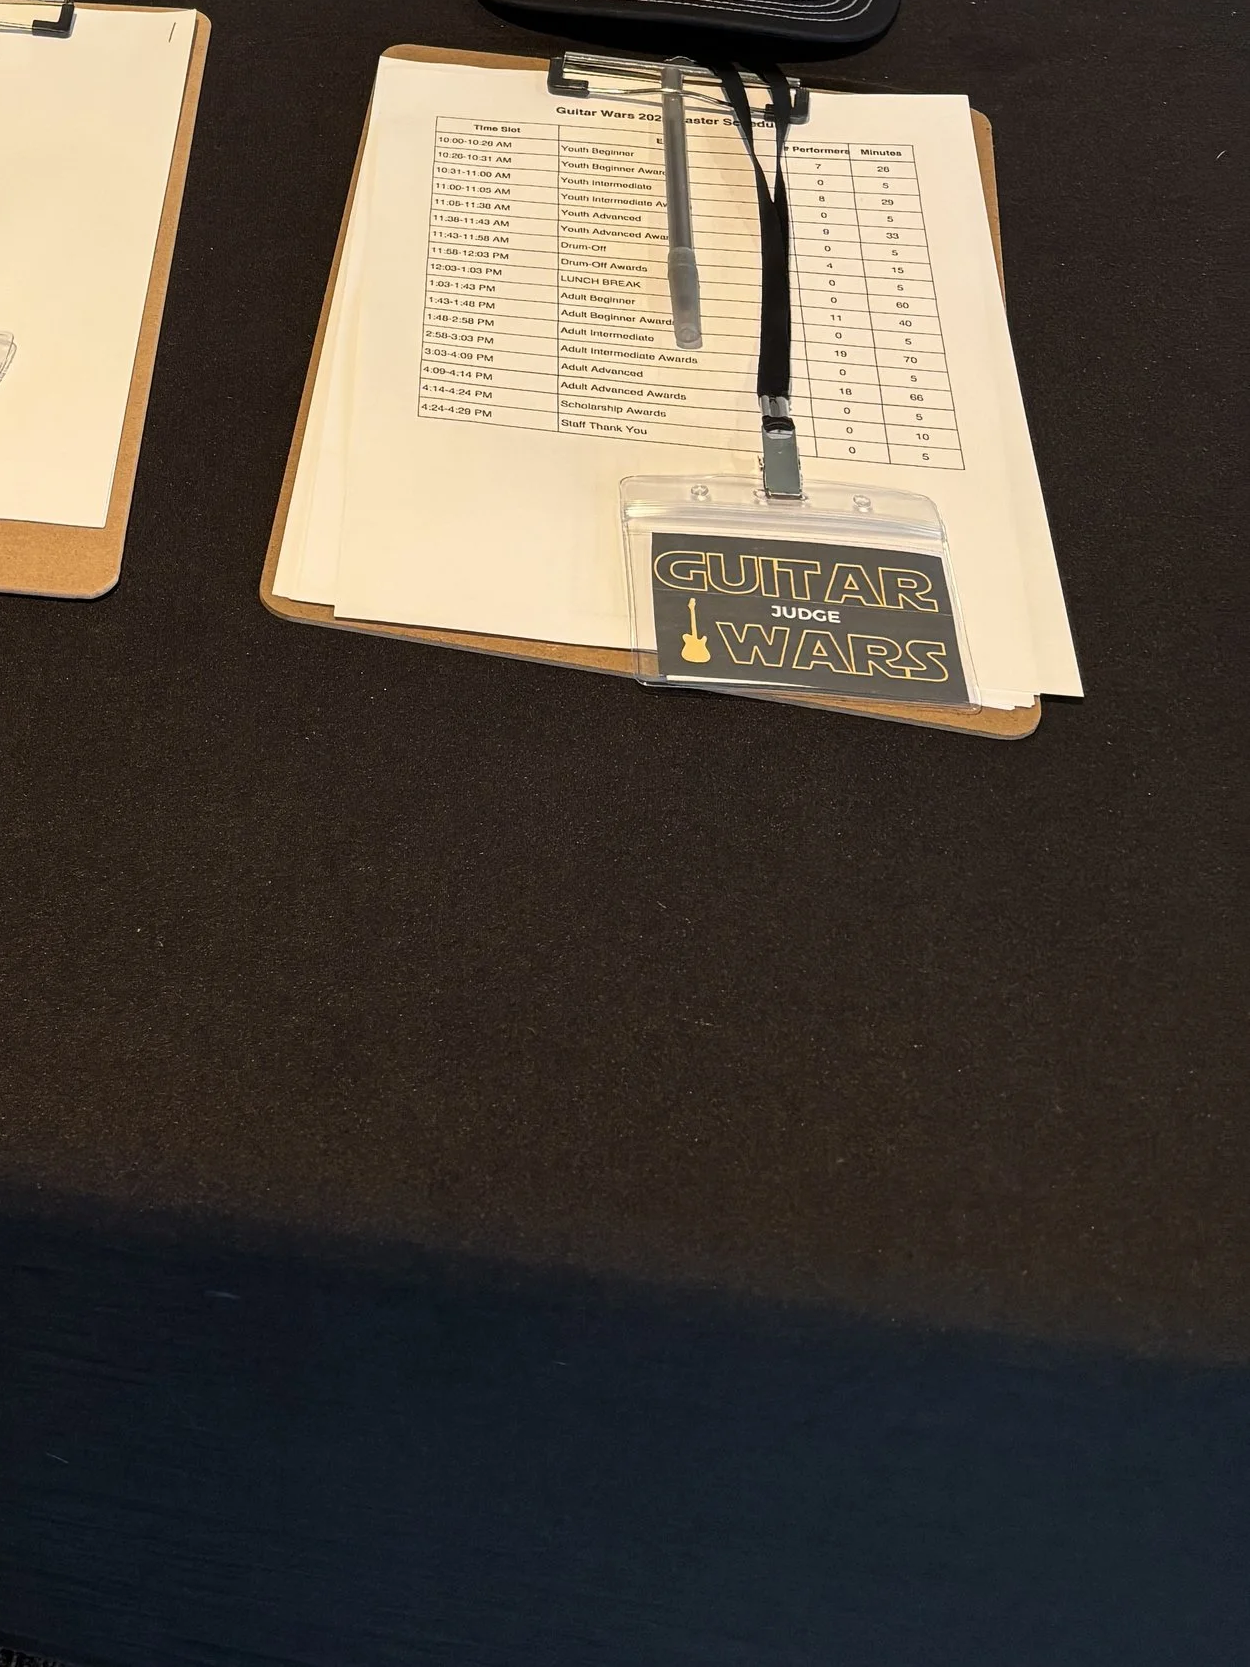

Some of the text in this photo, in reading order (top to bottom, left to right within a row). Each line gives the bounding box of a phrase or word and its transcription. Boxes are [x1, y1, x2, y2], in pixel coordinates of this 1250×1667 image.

[557, 107, 597, 116] Guitar
[601, 110, 634, 120] Wars
[638, 113, 662, 122] 202
[685, 117, 719, 126] aster
[561, 145, 634, 157] Youth Beginner
[793, 146, 849, 155] Performers
[861, 149, 902, 157] Minutes
[561, 161, 589, 169] Youth
[592, 164, 634, 174] Beginner
[561, 177, 652, 190] Youth Intermediate
[561, 193, 589, 201] Youth
[592, 196, 652, 207] Intermediate
[561, 209, 641, 222] Youth Advanced
[561, 225, 589, 233] Youth
[593, 228, 641, 238] Advanced
[561, 241, 606, 252] Drum-Off
[561, 258, 647, 272] Drum-Off Awards
[430, 280, 475, 290] 1:03-1:43
[561, 275, 641, 288] LUNCH BREAK
[429, 297, 475, 307] 1:43-1:48
[561, 292, 635, 304] Adult Beginner
[428, 314, 474, 324] 1:48-2:58
[561, 310, 587, 318] Adult
[590, 312, 635, 321] Beginner
[426, 331, 473, 341] 2:58-3:03
[561, 327, 654, 341] Adult Intermediate
[425, 348, 473, 359] 3:03-4:09
[561, 345, 698, 364] Adult Intermediate Awards
[423, 366, 472, 378] 4:09-4:14
[561, 363, 643, 377] Adult Advanced
[422, 385, 471, 396] 4:14-4:24
[561, 382, 686, 400] Adult Advanced Awards
[421, 404, 471, 415] 4:24-4:29
[561, 400, 666, 417] Scholarship Awards
[561, 419, 647, 435] Staff Thank You
[654, 550, 939, 613] GUITAR
[771, 605, 841, 623] JUDGE
[716, 622, 948, 682] WARS
